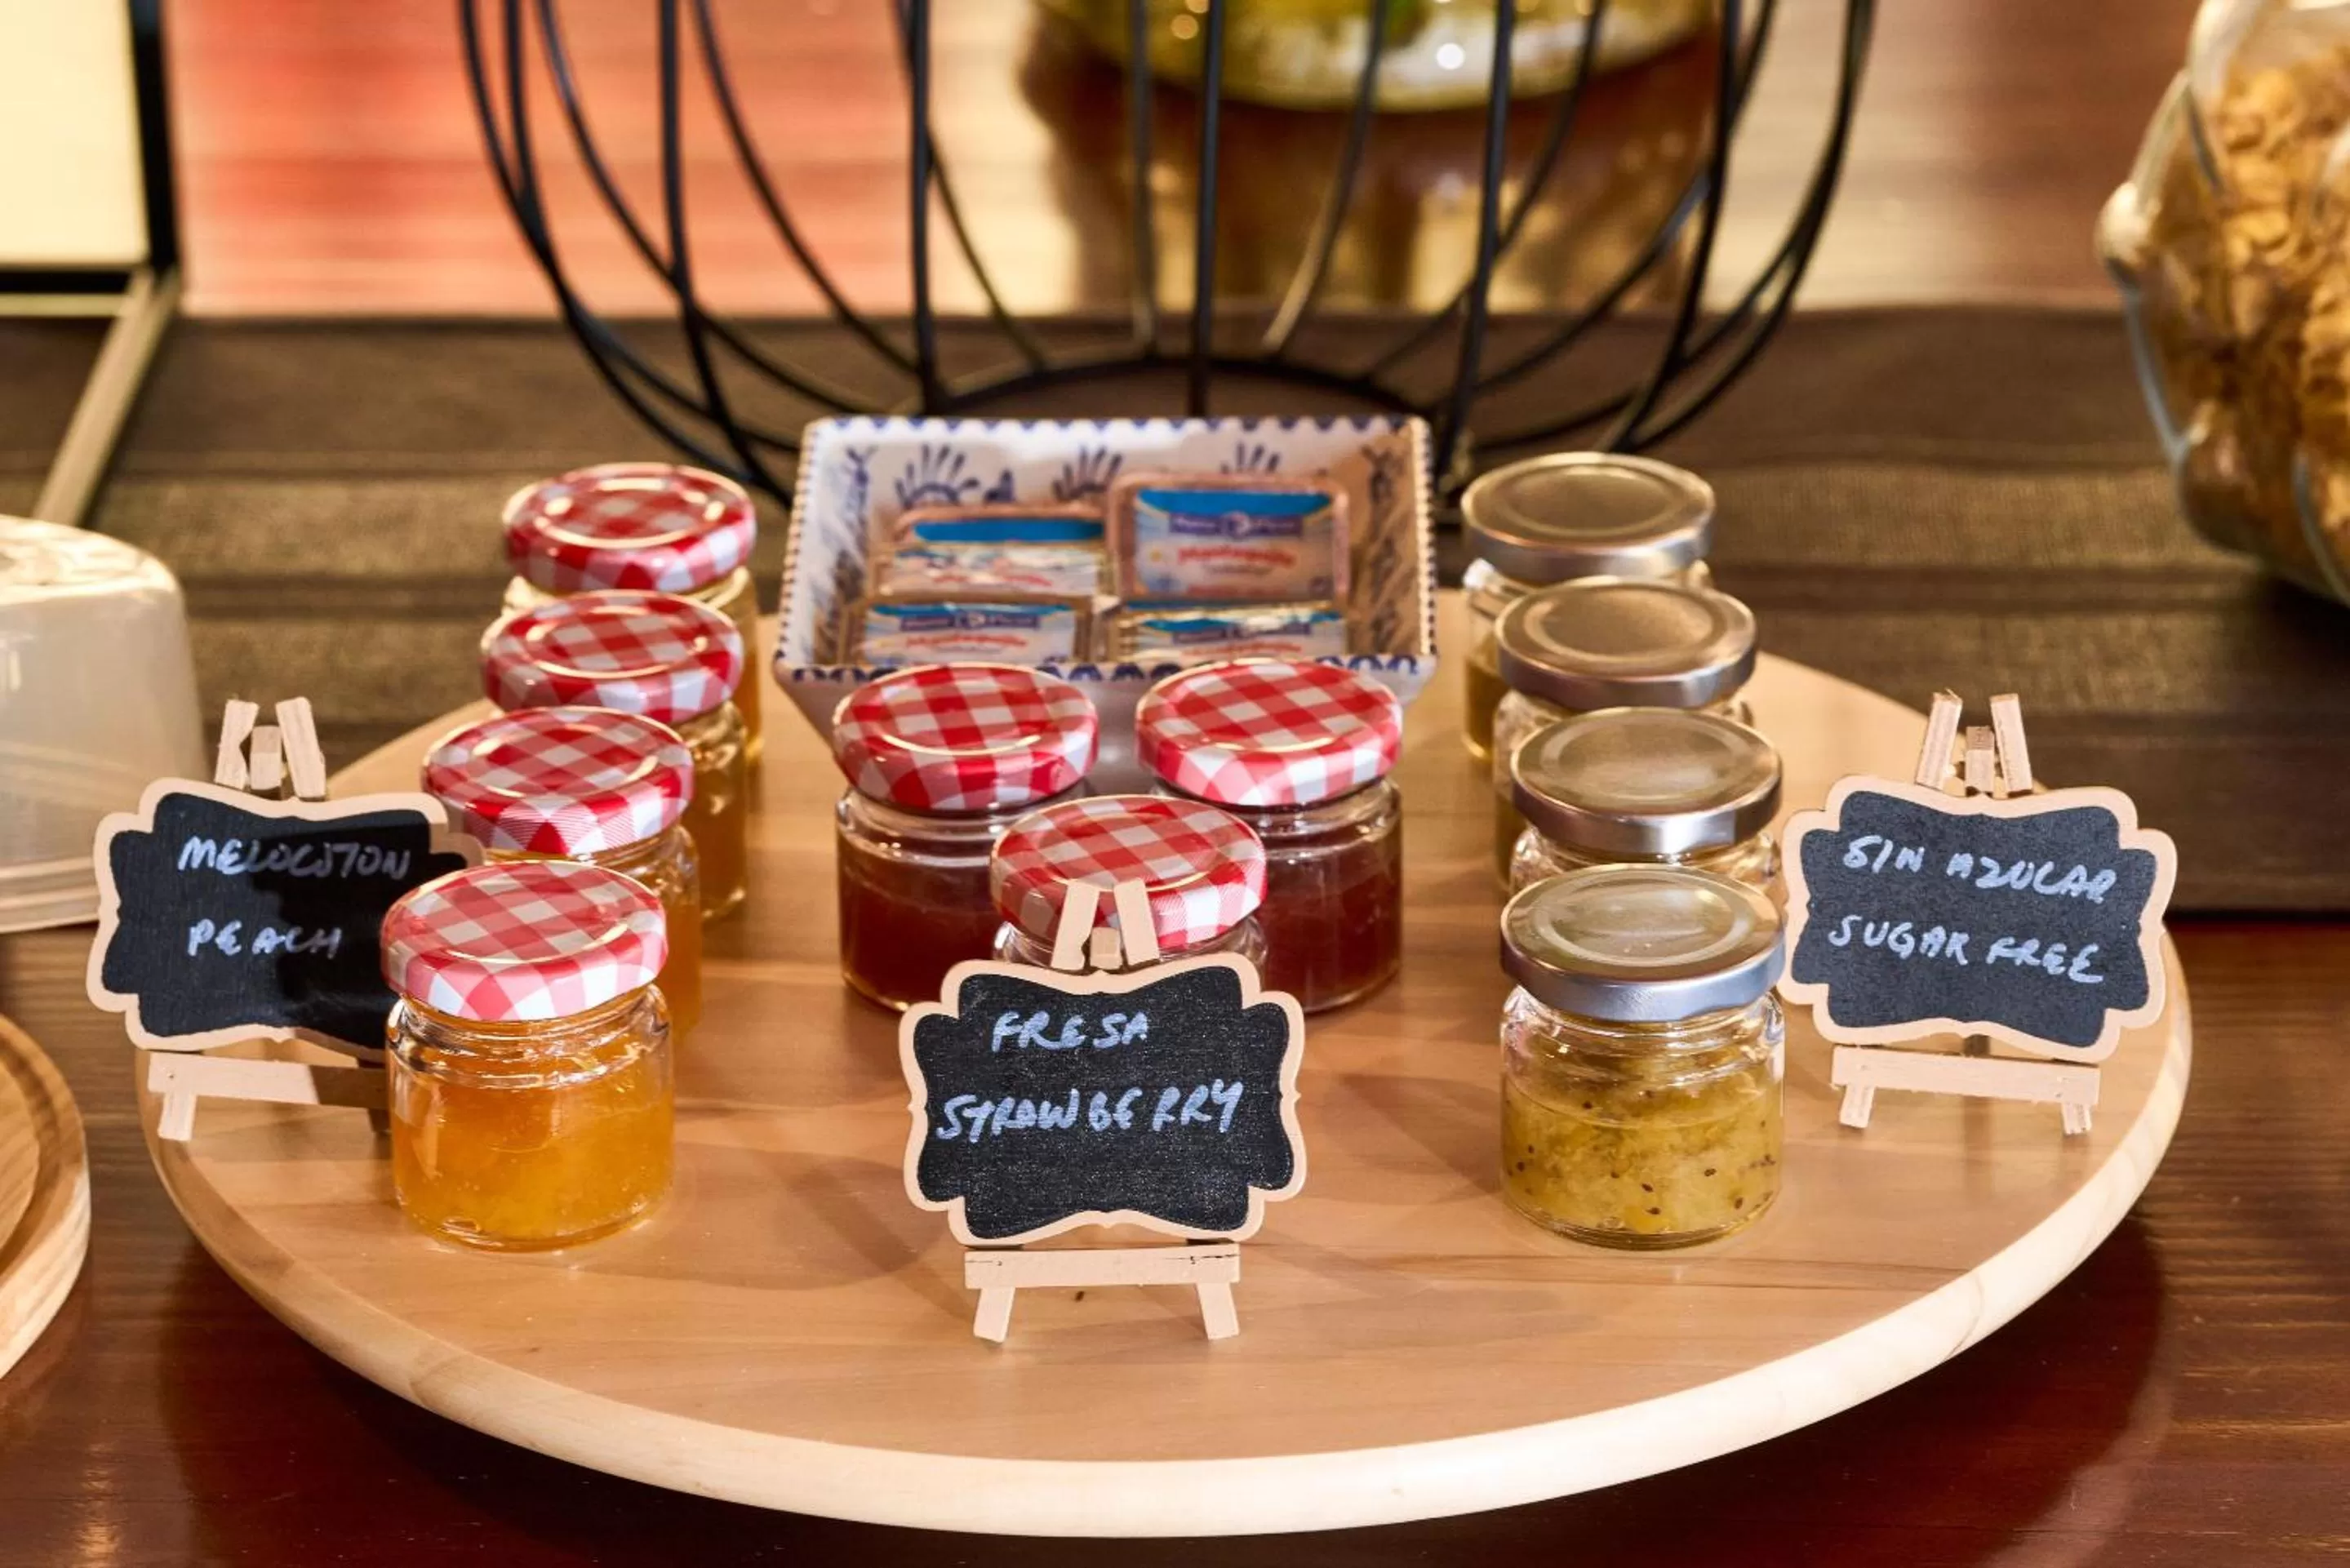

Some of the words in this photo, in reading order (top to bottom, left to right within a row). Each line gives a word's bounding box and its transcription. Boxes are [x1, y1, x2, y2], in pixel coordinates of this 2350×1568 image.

[1842, 834, 1926, 873] SIN
[1946, 852, 2118, 904] AZUCAR
[186, 918, 343, 960] PEACH
[1828, 915, 1970, 966] SUGAR
[1985, 935, 2104, 984] FREE
[990, 1010, 1149, 1053] FRESA
[936, 1077, 1245, 1144] STRAWBERRY
